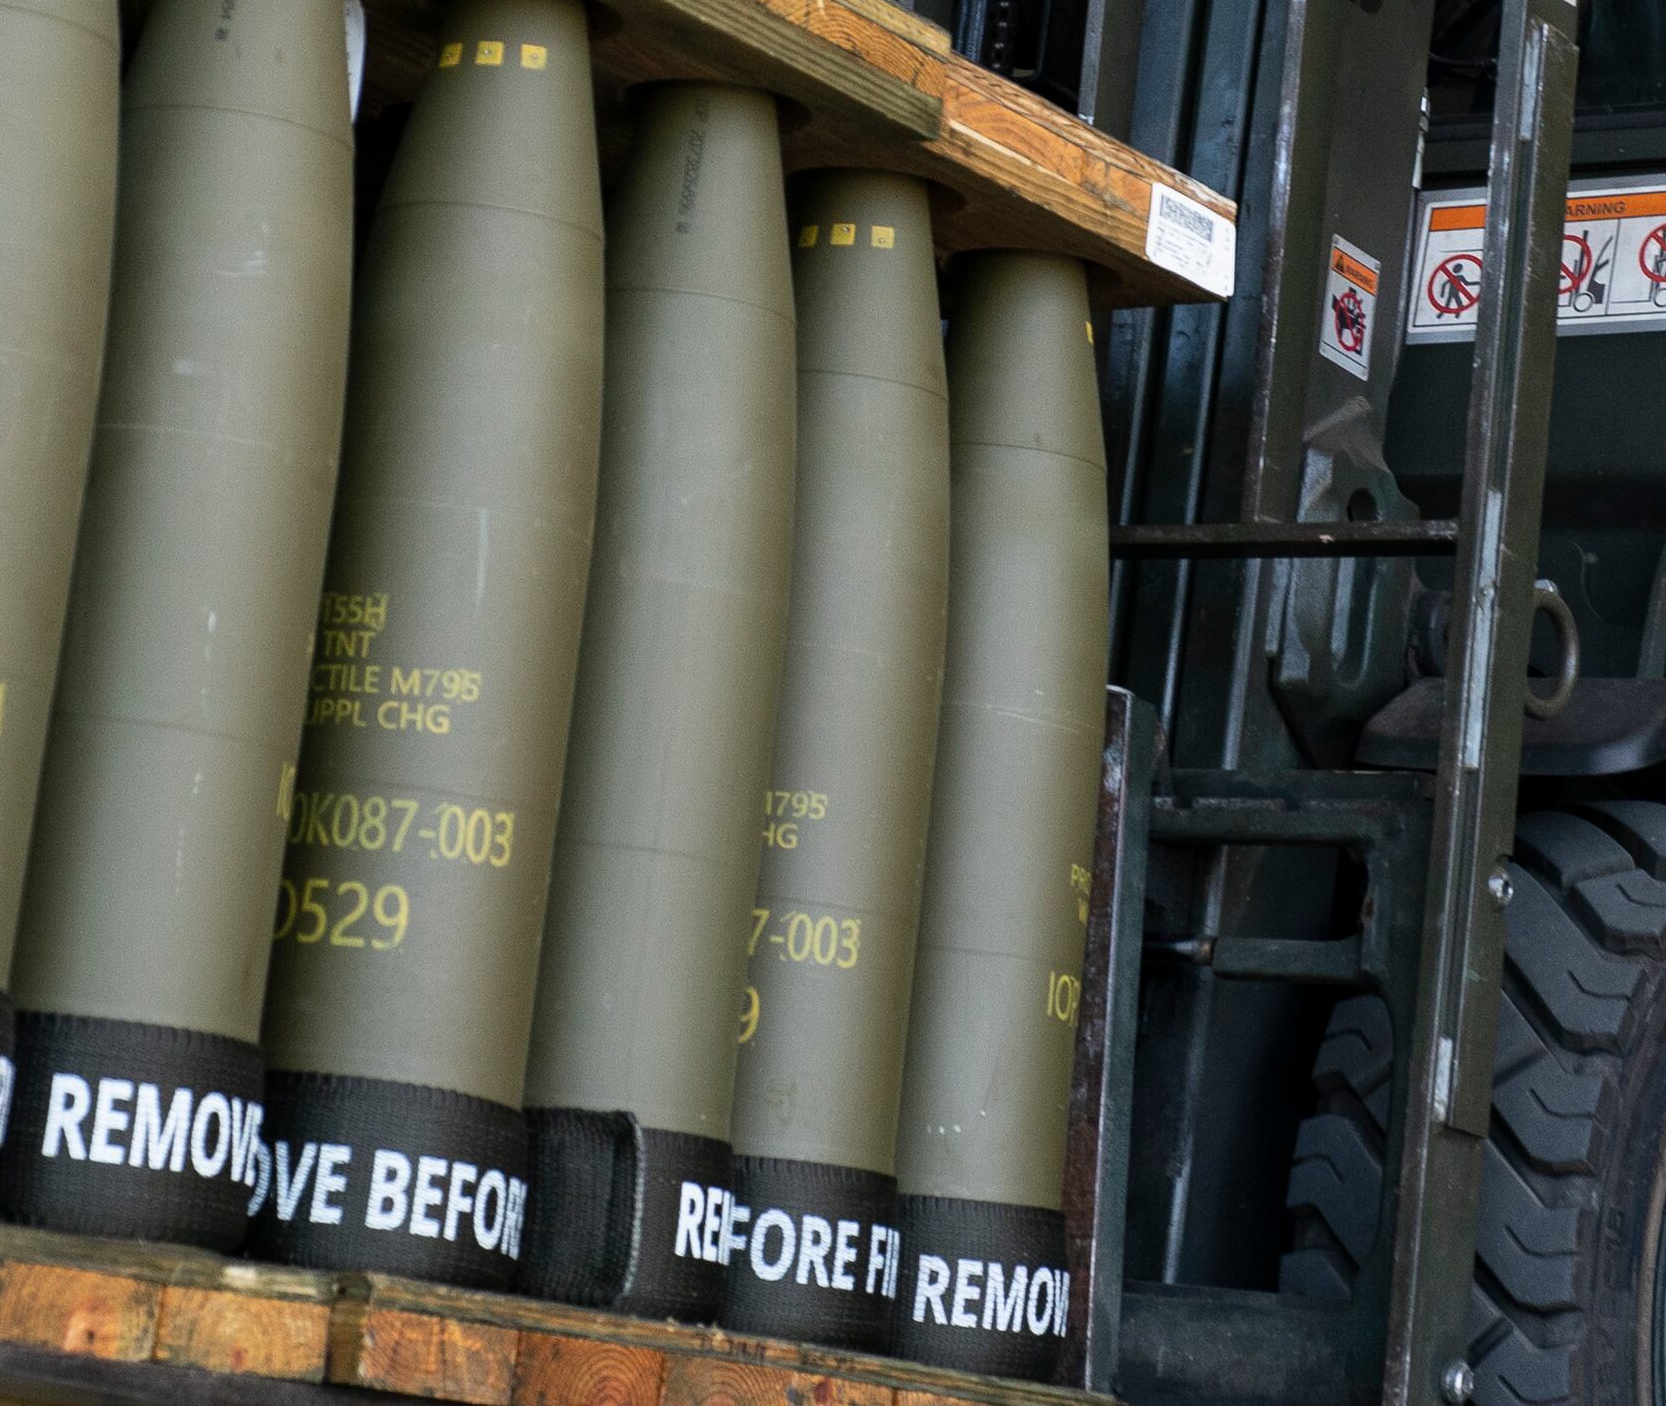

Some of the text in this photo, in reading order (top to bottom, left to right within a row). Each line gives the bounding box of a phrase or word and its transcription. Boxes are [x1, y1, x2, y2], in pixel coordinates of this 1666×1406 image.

[324, 630, 376, 659] TNT
[391, 667, 482, 704] M795
[378, 700, 452, 734] CHG
